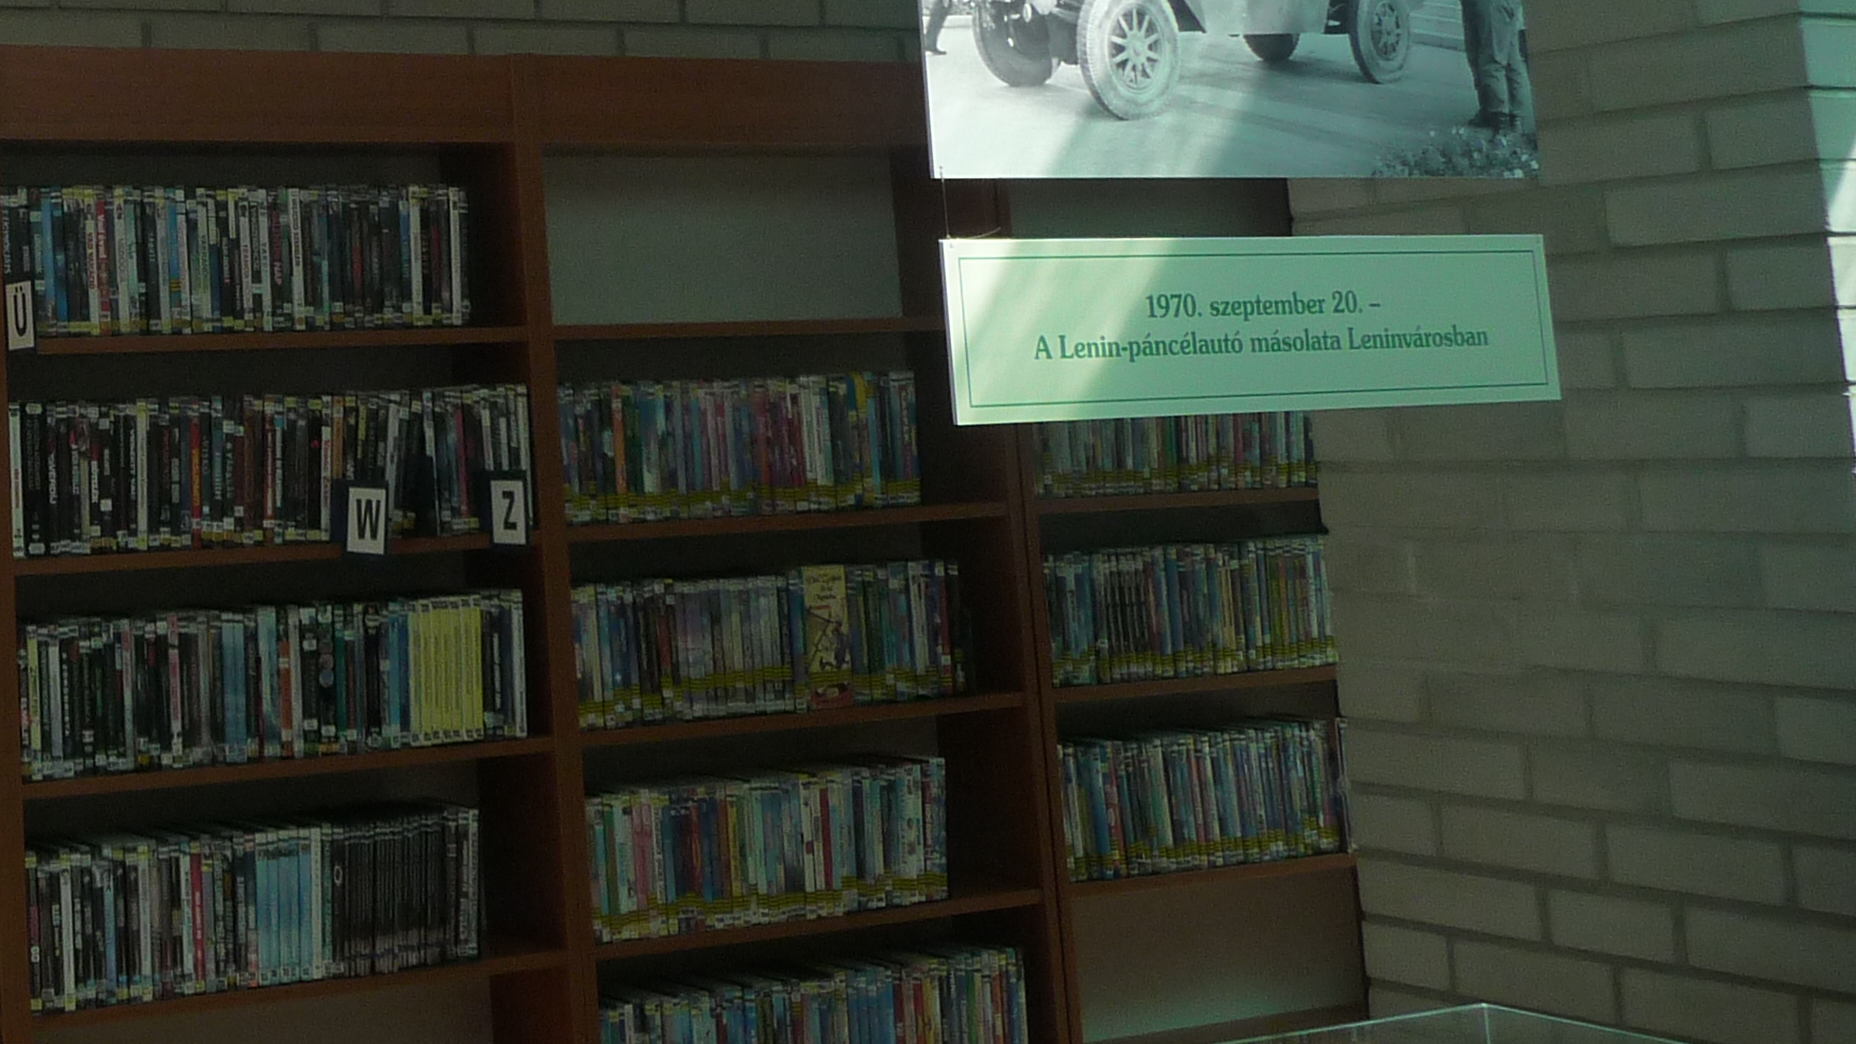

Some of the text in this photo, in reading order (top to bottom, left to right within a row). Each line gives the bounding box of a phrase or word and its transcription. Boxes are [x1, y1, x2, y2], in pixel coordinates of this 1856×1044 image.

[13, 286, 29, 337] Ü
[1146, 292, 1203, 319] 1970.
[1209, 290, 1327, 322] szeptember
[1332, 289, 1364, 314] 20.
[1034, 323, 1490, 363] A Lenin-páncélautó másolata Leninvárosban
[356, 498, 380, 540] W
[502, 490, 518, 531] Z
